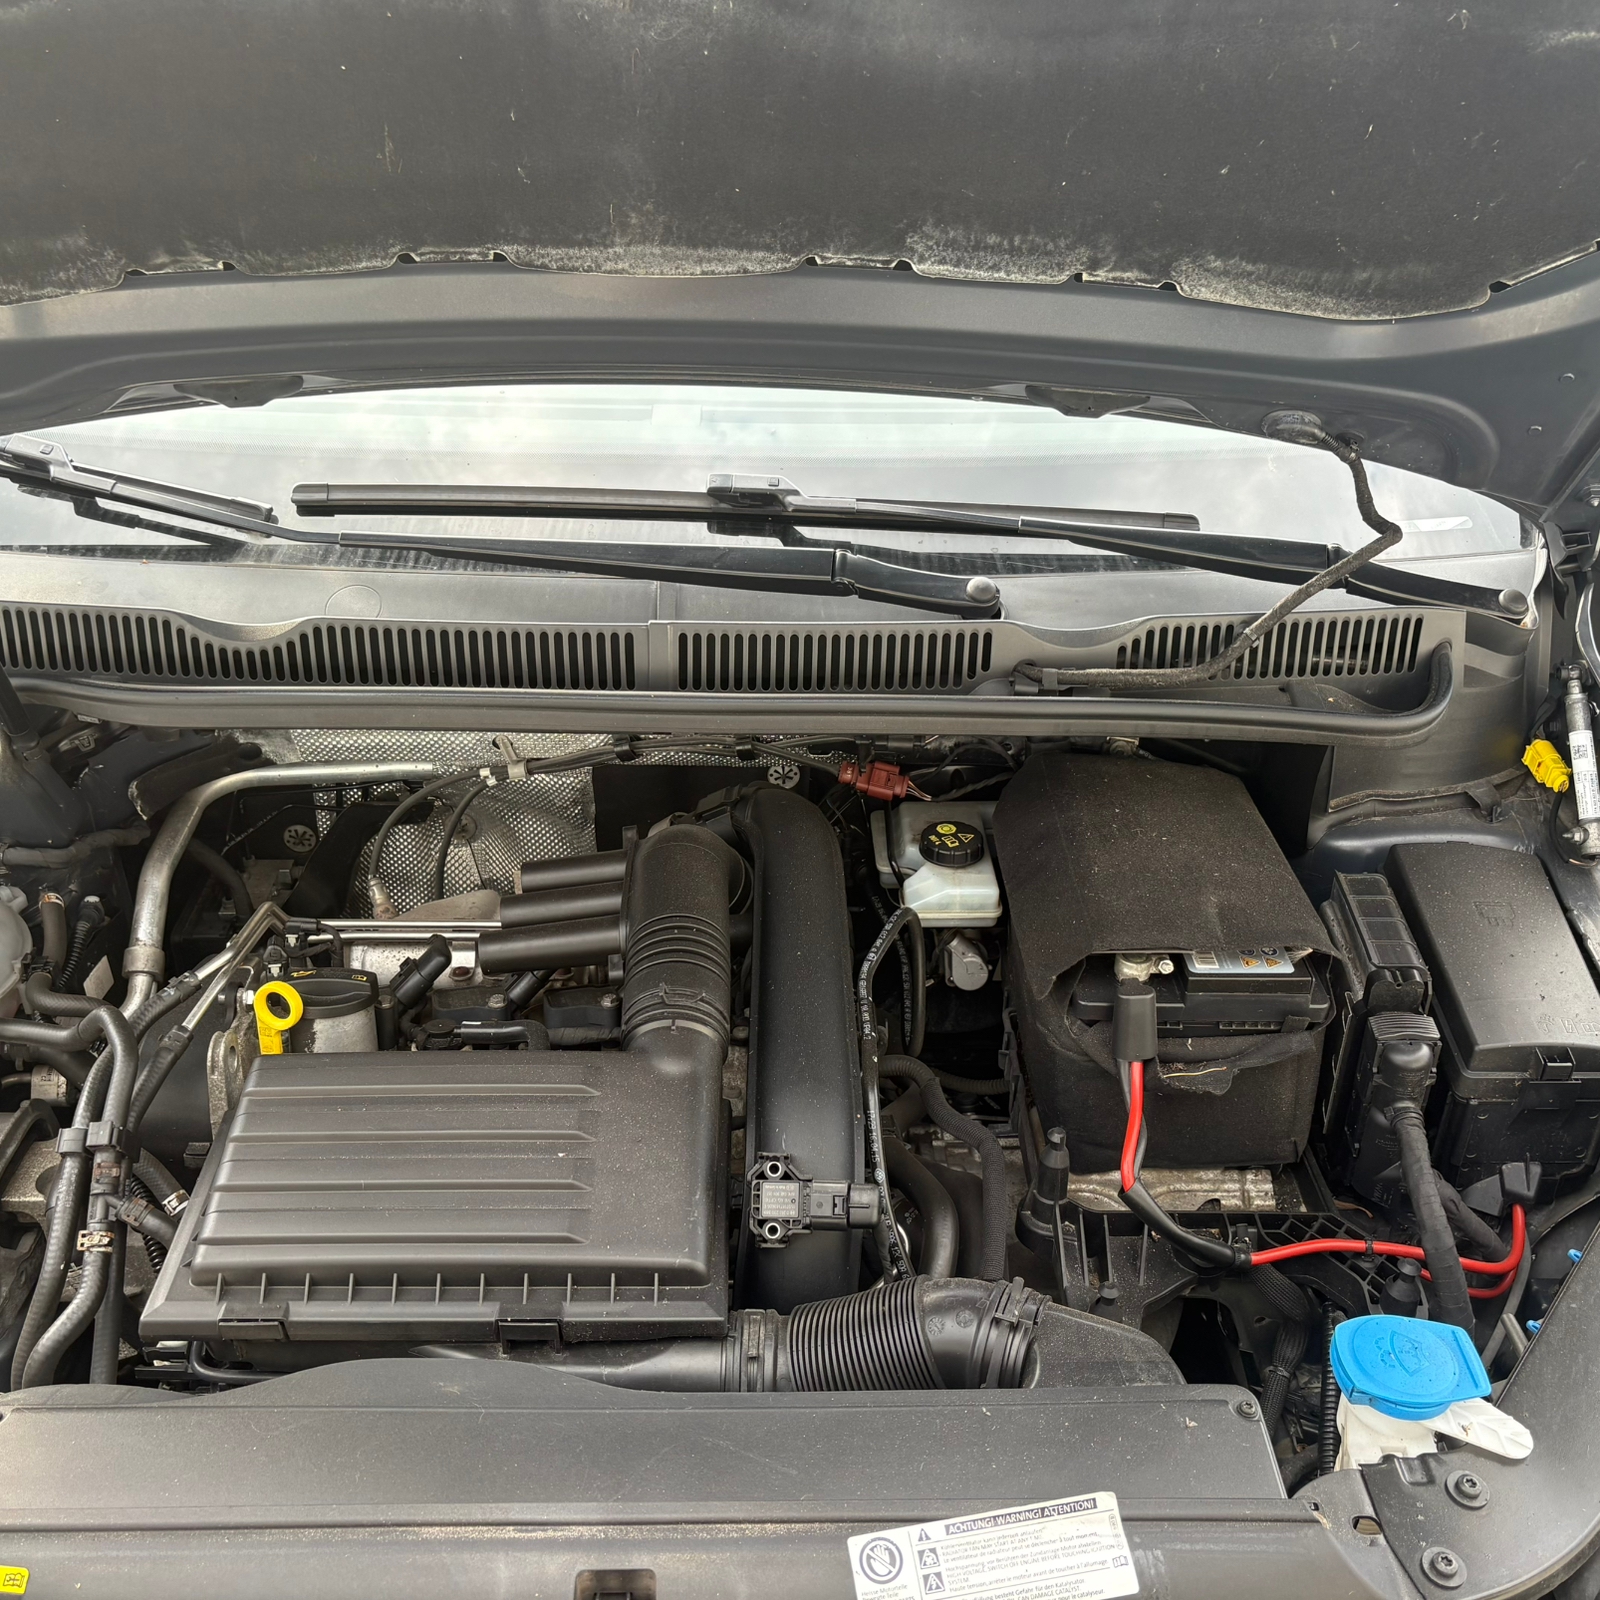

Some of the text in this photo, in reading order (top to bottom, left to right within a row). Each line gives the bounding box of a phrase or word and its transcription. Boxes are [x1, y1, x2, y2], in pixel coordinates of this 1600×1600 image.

[948, 1499, 1094, 1533] ACHTUNG! WARNING! ATTENTION!
[994, 1590, 1014, 1599] besteht
[1030, 1590, 1054, 1599] DAMAGE
